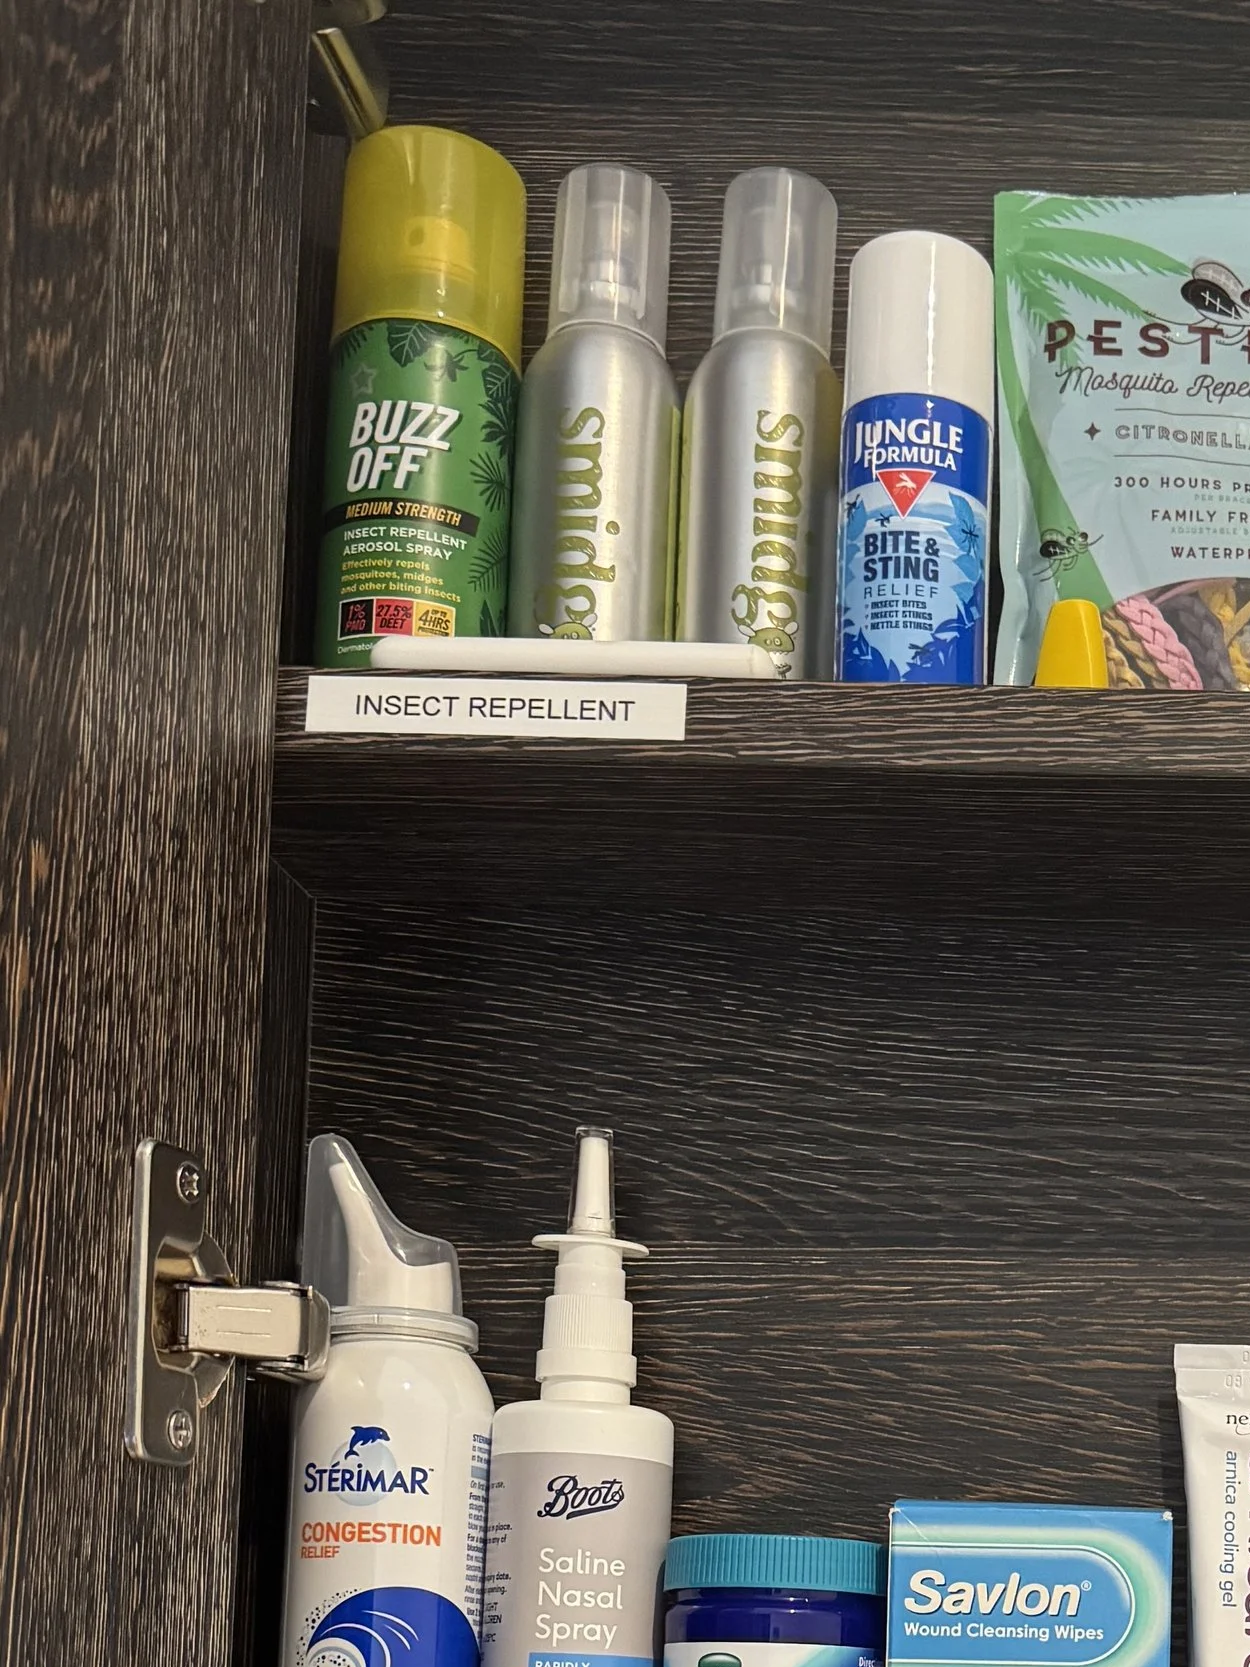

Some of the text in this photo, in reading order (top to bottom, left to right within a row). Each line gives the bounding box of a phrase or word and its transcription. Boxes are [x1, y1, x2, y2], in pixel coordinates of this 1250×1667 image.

[1055, 366, 1179, 399] Mosquito
[349, 400, 461, 450] BUZZ
[854, 418, 964, 463] JUNGLE
[346, 445, 429, 493] OFF
[864, 447, 957, 471] FORMULA
[1114, 476, 1149, 488] 300
[1160, 477, 1222, 491] HOURS
[345, 501, 462, 526] MEDIUM STRENGTH
[1151, 509, 1217, 523] FAMILY
[343, 527, 468, 550] INSECT REPELLENT
[343, 541, 453, 560] AEROSOL SPRAY
[864, 530, 920, 557] BITE
[863, 556, 939, 583] STING
[864, 583, 938, 599] RELIEF
[355, 694, 636, 721] INSECT REPELLENT
[536, 1475, 625, 1520] Boots
[301, 1521, 442, 1547] CONGESTION
[1219, 1451, 1242, 1608] arnica cooling gel
[300, 1546, 340, 1559] RELIEF
[538, 1547, 626, 1577] Saline
[537, 1580, 623, 1610] Nasal
[904, 1569, 1081, 1617] Savlon
[535, 1613, 618, 1649] Spray
[904, 1622, 1104, 1642] Wound Cleansing Wipes
